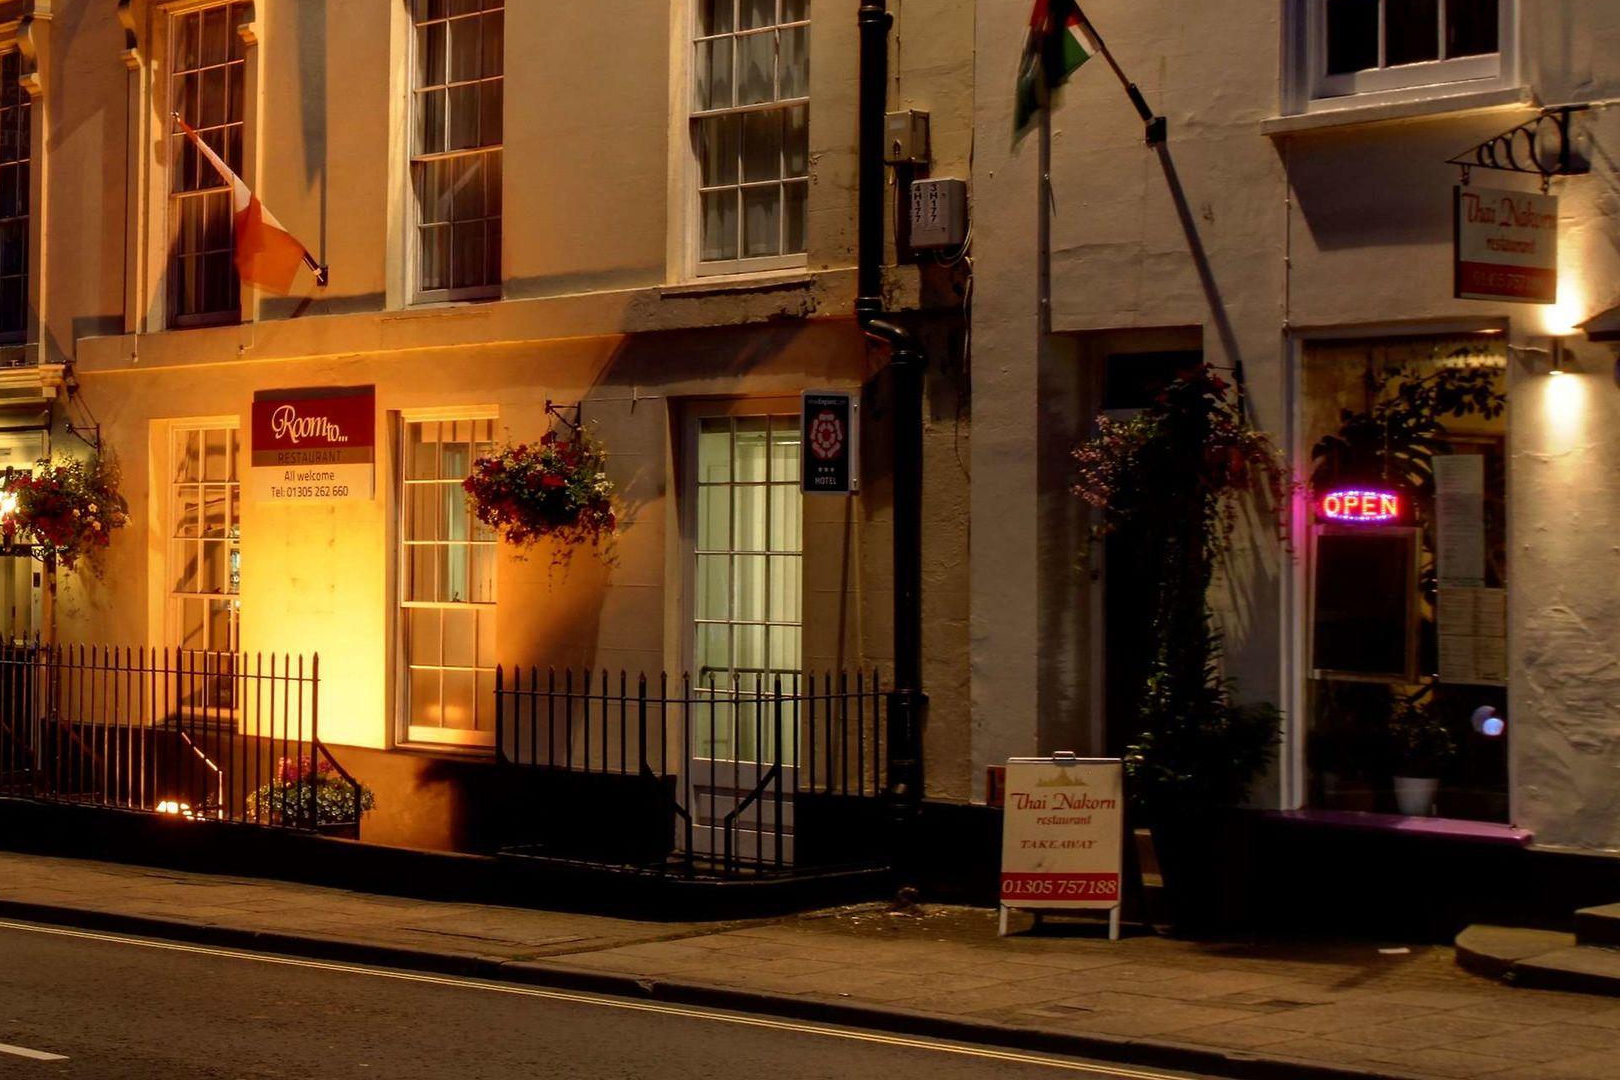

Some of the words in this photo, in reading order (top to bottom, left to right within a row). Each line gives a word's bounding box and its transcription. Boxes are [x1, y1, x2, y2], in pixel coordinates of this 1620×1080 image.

[271, 405, 328, 444] Room
[277, 450, 341, 464] RESTAURANT
[284, 470, 295, 481] All
[298, 470, 335, 481] welcome
[814, 476, 837, 485] HOTEL
[286, 486, 313, 497] 01305
[315, 485, 330, 497] 262
[332, 485, 349, 497] 660
[1323, 495, 1398, 516] OPEN
[1010, 792, 1047, 810] Thai
[1051, 792, 1116, 811] Nakorn
[1036, 815, 1092, 825] restaurant
[1020, 839, 1098, 850] TAKEAWAY
[1002, 879, 1053, 894] 01305
[1057, 879, 1118, 895] 757188
